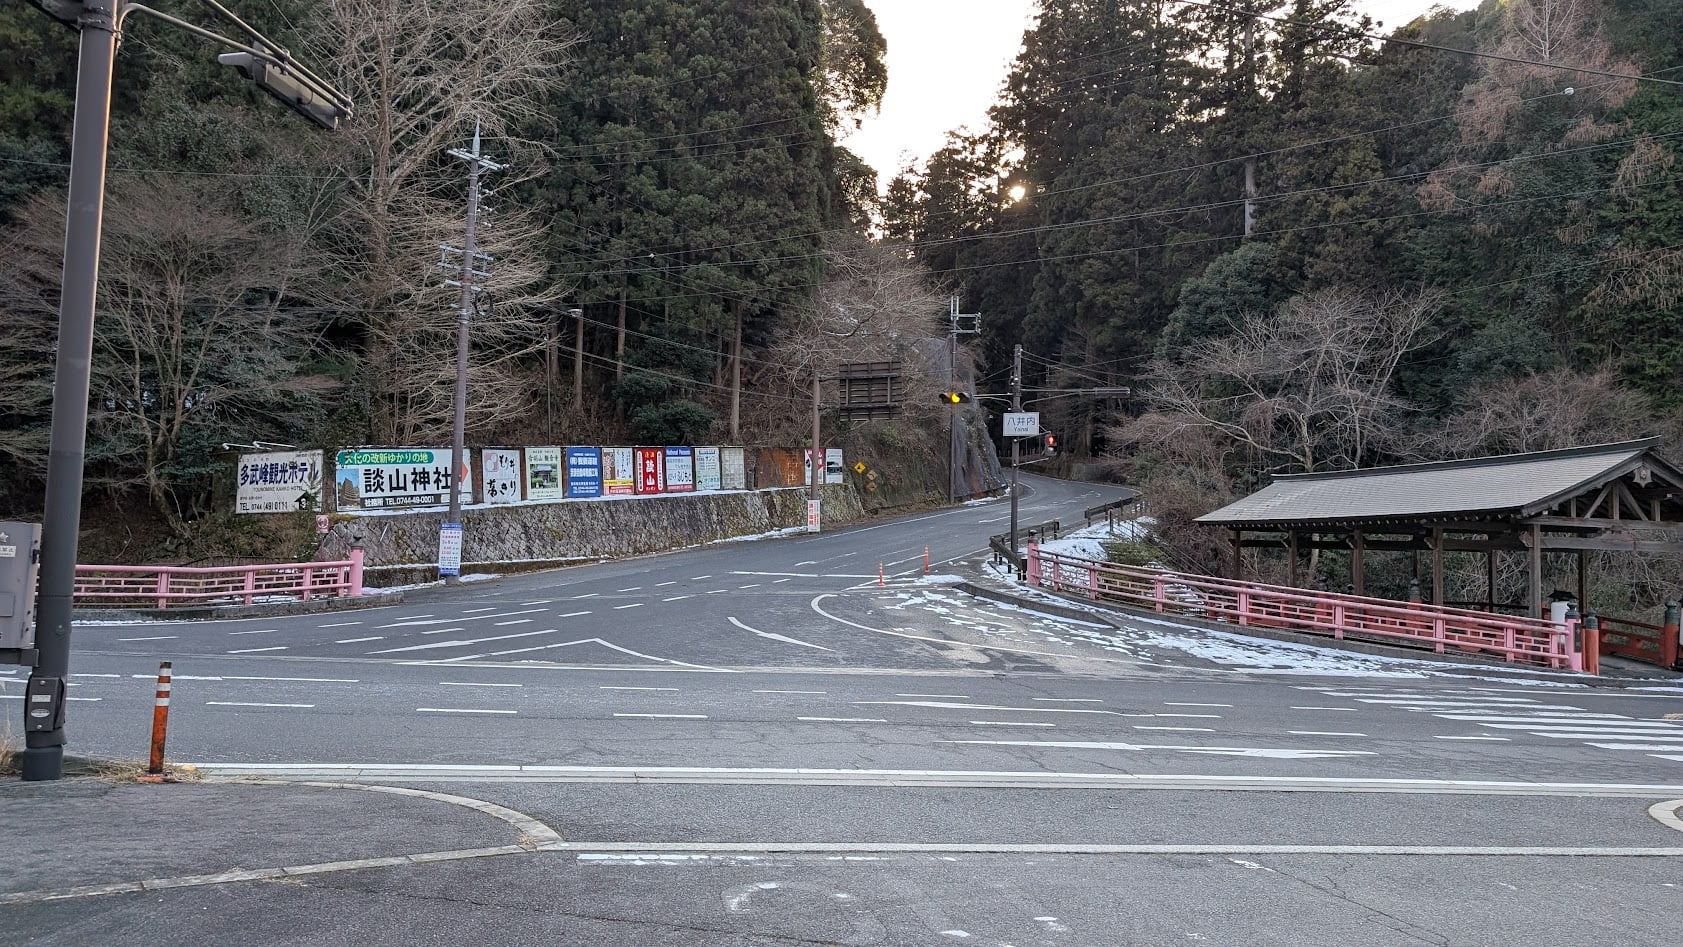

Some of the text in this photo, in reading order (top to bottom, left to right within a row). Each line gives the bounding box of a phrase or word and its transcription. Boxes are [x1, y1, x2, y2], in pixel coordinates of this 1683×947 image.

[1008, 416, 1036, 426] 八井内
[344, 452, 429, 465] 大化の改新ゆかりの地
[240, 461, 319, 487] 多武峰観光ホテル
[363, 466, 451, 494] 談山神社
[240, 502, 250, 511] TEL
